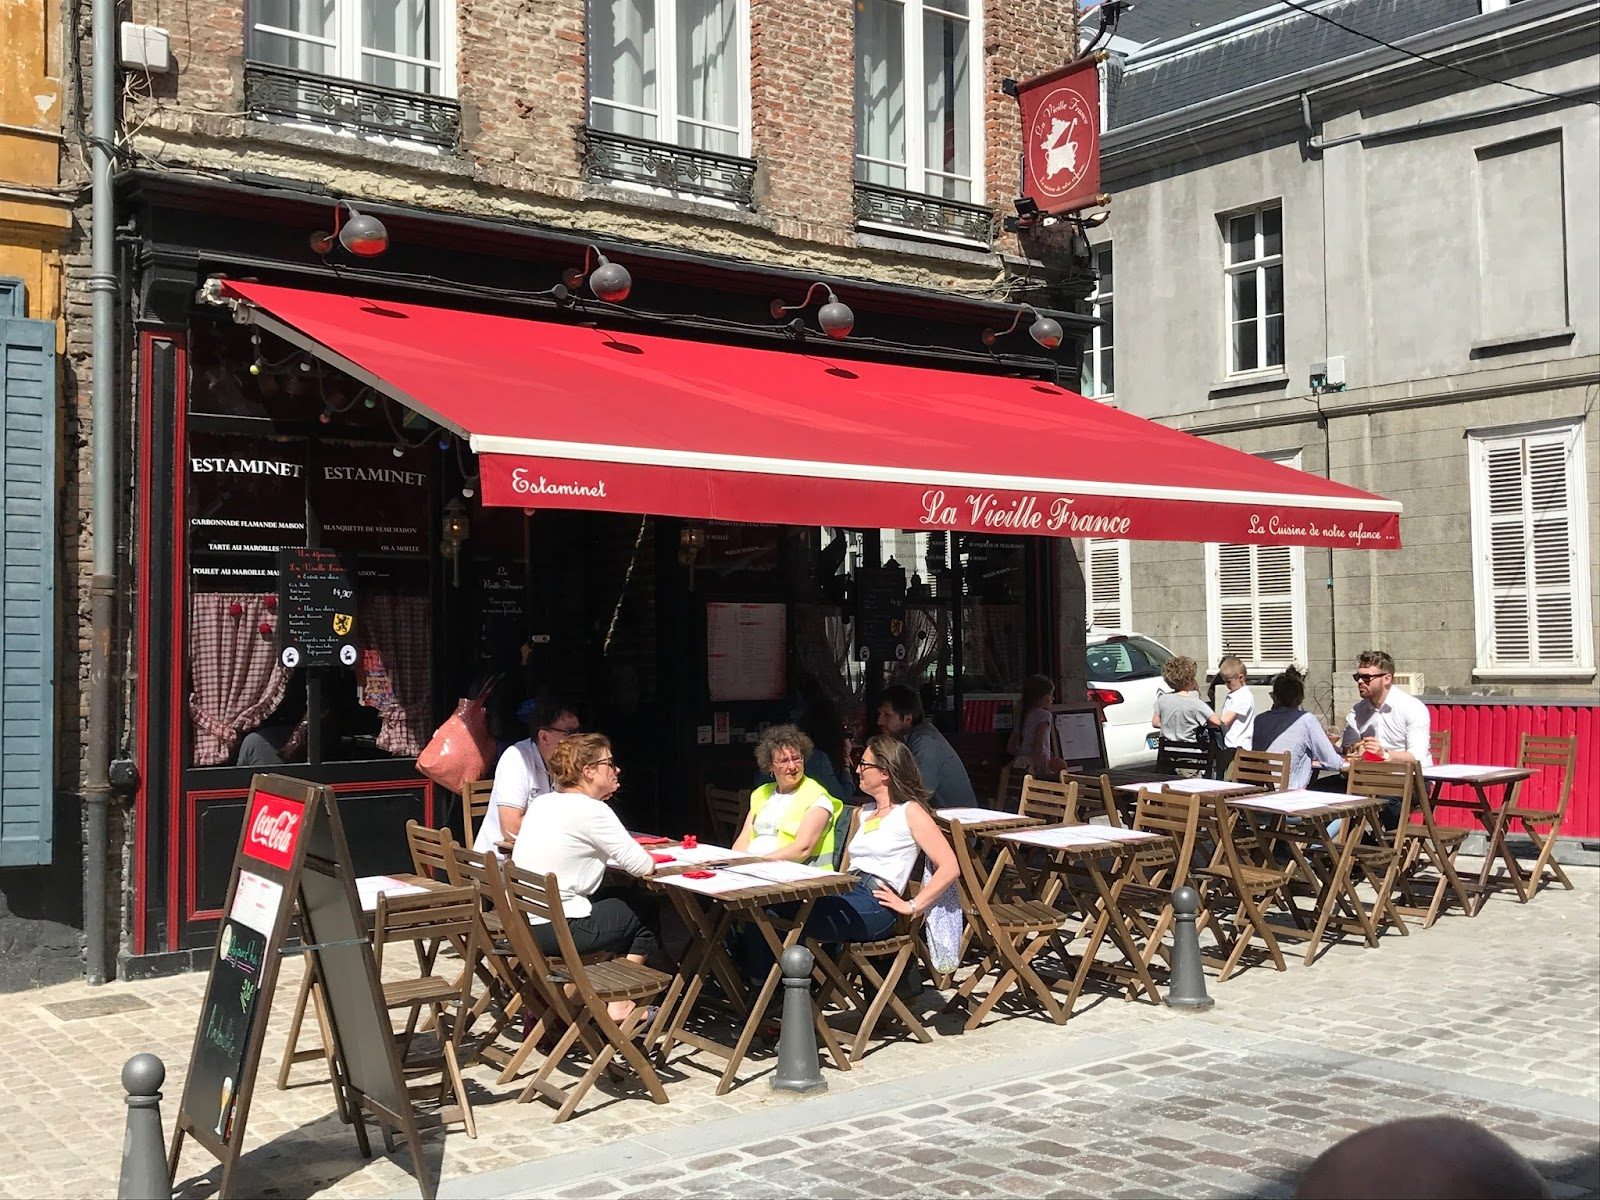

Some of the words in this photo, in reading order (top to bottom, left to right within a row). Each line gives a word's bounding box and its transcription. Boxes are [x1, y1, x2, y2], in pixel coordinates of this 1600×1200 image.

[1042, 100, 1067, 118] Vieille
[1068, 98, 1088, 124] France
[191, 458, 304, 478] ESTAMINET
[324, 466, 426, 486] ESTAMINET
[512, 468, 607, 498] Estaminet
[919, 490, 957, 525] La
[965, 492, 1042, 528] Vieille
[1046, 498, 1130, 534] France
[192, 518, 240, 527] CARBONNADE
[240, 520, 278, 528] FLAMANDE
[278, 522, 304, 530] MAISON
[1248, 514, 1265, 534] La
[1269, 516, 1307, 536] Cuisine
[1309, 523, 1320, 536] de
[1322, 524, 1346, 538] notre
[1348, 522, 1382, 546] enfance
[242, 544, 280, 552] MAROILLES
[220, 568, 231, 576] AU
[232, 568, 266, 576] MAROILLE
